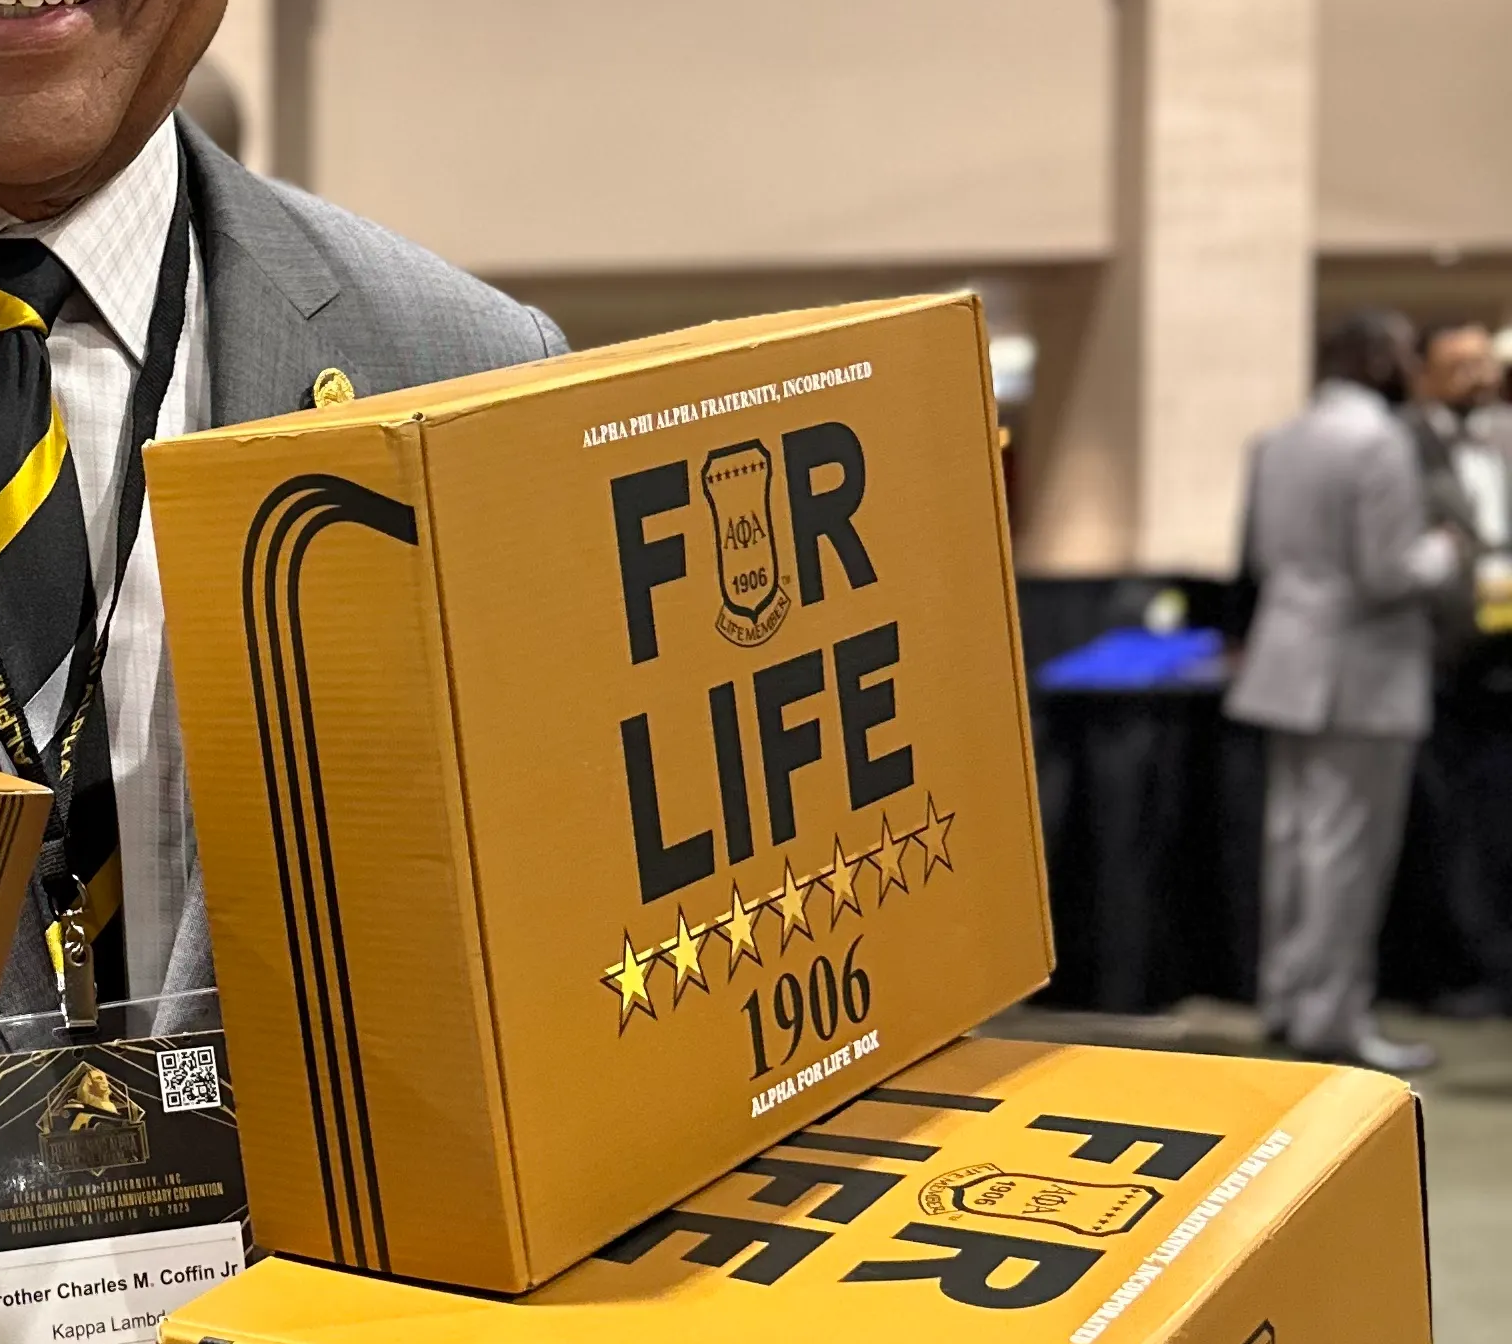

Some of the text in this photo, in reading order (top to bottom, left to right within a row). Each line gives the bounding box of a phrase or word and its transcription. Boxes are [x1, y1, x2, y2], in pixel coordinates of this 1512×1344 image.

[583, 361, 872, 448] ALPHA PHI ALPHA FRATERNITY, INCORPORATED
[732, 567, 768, 595] 1906
[719, 597, 788, 641] LIFE MEMBER
[620, 621, 915, 906] LIFE
[741, 934, 870, 1081] 1906
[751, 1029, 880, 1118] ALPHA FOR LIFE BOX
[951, 1164, 995, 1183] LIFE
[974, 1180, 1017, 1206] 1906
[0, 1205, 36, 1223] GENERAL
[35, 1198, 88, 1218] CONVENTION
[117, 1188, 173, 1207] ANNIVERSARY
[172, 1181, 224, 1201] CONVENTION
[57, 1277, 127, 1299] Charles
[133, 1272, 154, 1290] M.
[160, 1265, 215, 1286] Coffin
[220, 1261, 239, 1278] Jr
[52, 1320, 106, 1341] Kappa
